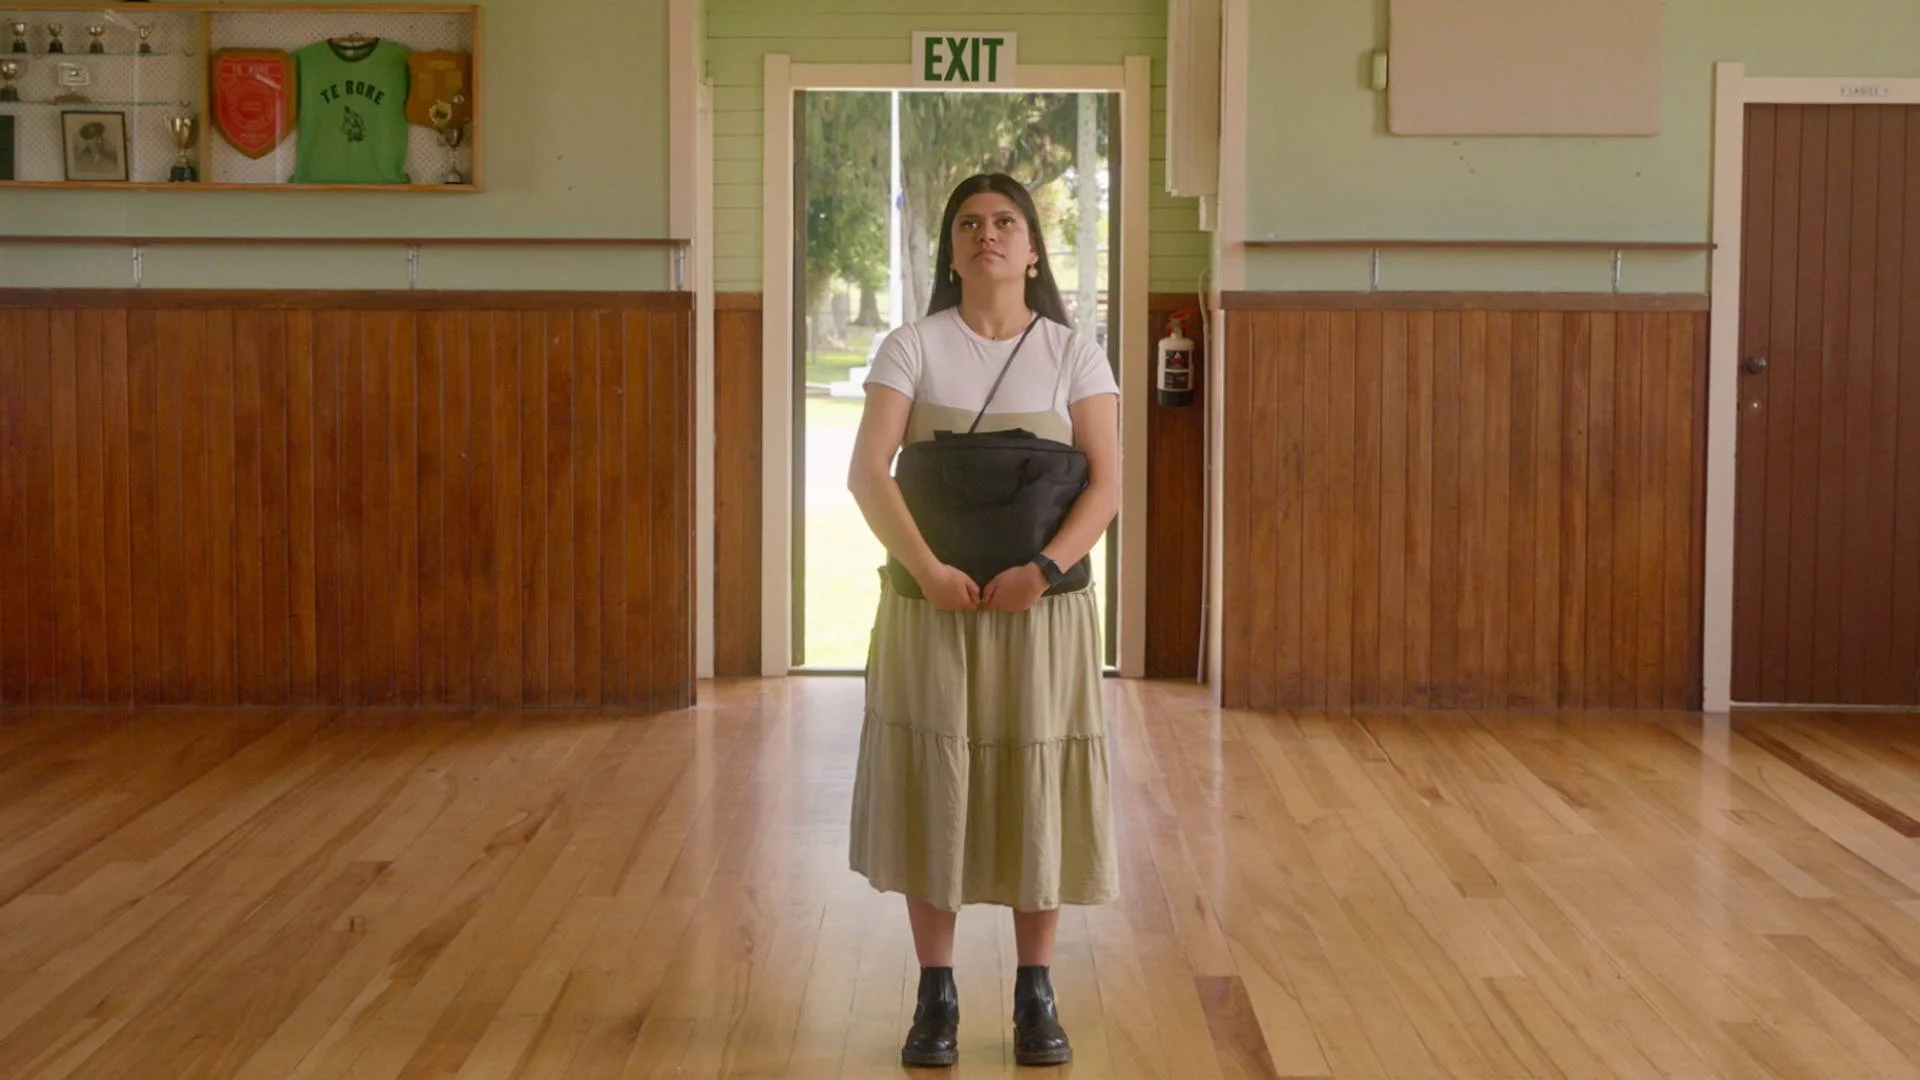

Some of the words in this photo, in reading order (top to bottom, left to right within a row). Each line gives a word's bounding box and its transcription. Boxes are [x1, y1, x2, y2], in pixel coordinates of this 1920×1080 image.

[924, 37, 1004, 82] EXIT
[319, 84, 340, 104] TE
[345, 80, 385, 105] RORE
